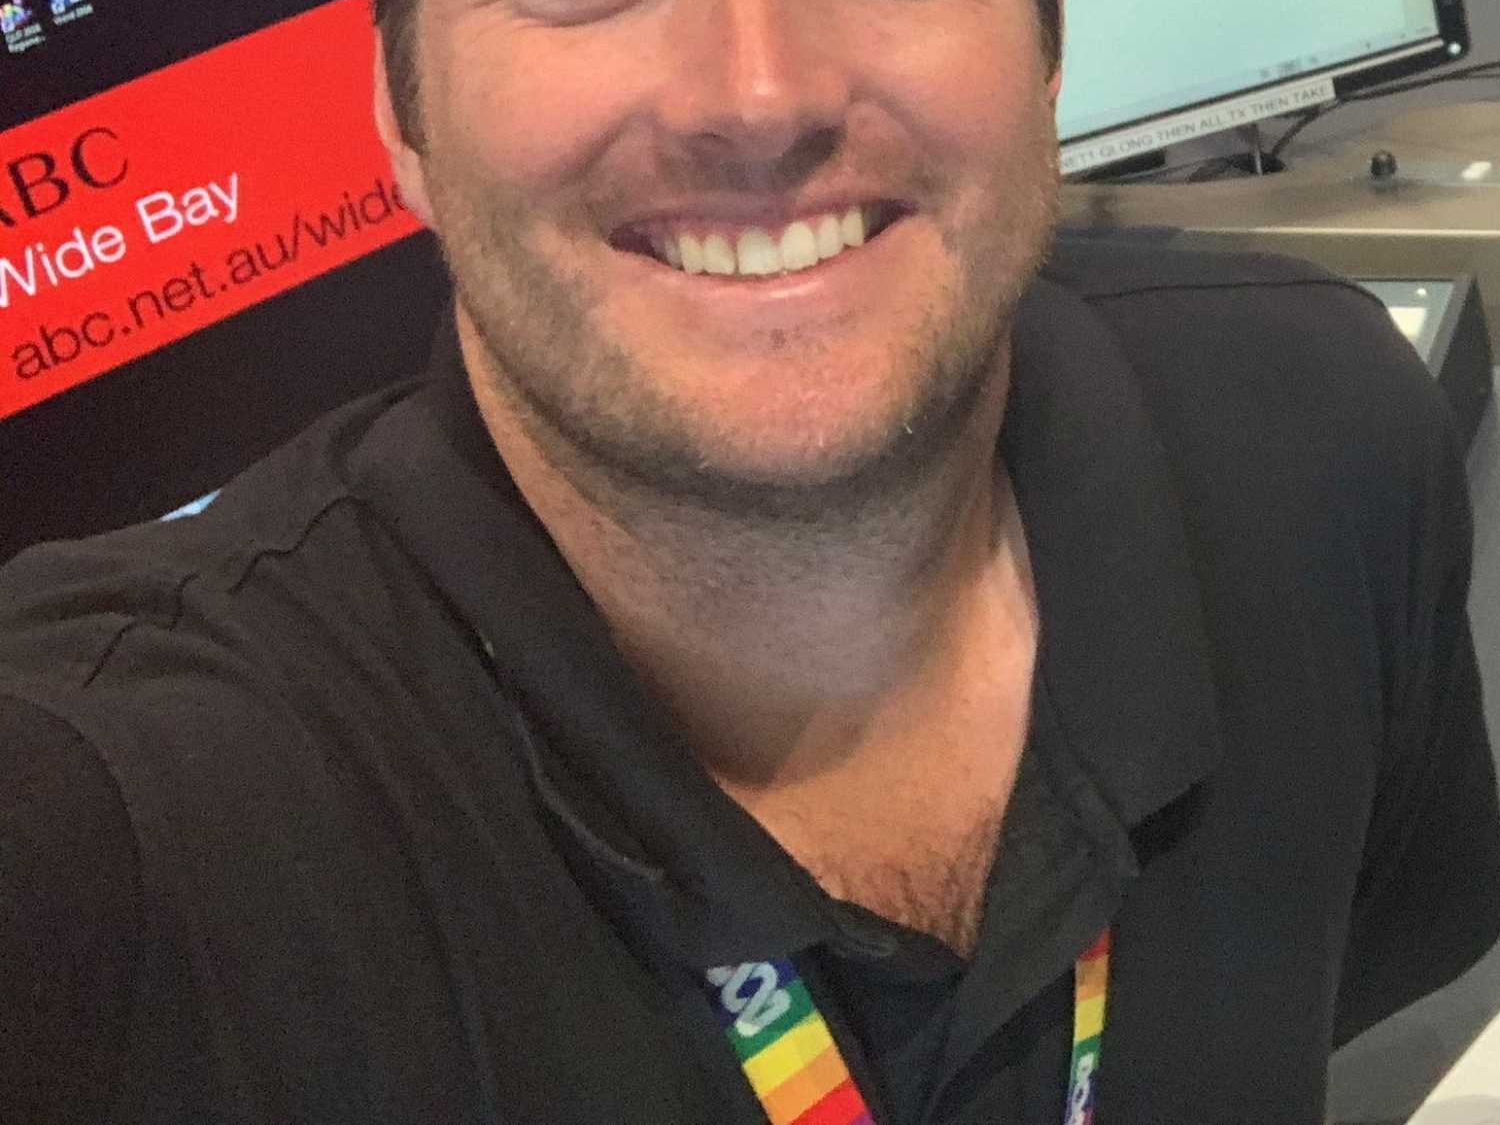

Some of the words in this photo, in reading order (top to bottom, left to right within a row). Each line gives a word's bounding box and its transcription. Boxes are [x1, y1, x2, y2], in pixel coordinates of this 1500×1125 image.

[1156, 122, 1196, 144] THEN
[1199, 115, 1223, 131] ALL
[1229, 108, 1248, 122] TX
[1250, 97, 1290, 117] THEN
[1292, 85, 1328, 105] TAKE
[0, 126, 128, 227] BC
[136, 172, 240, 243] Bay
